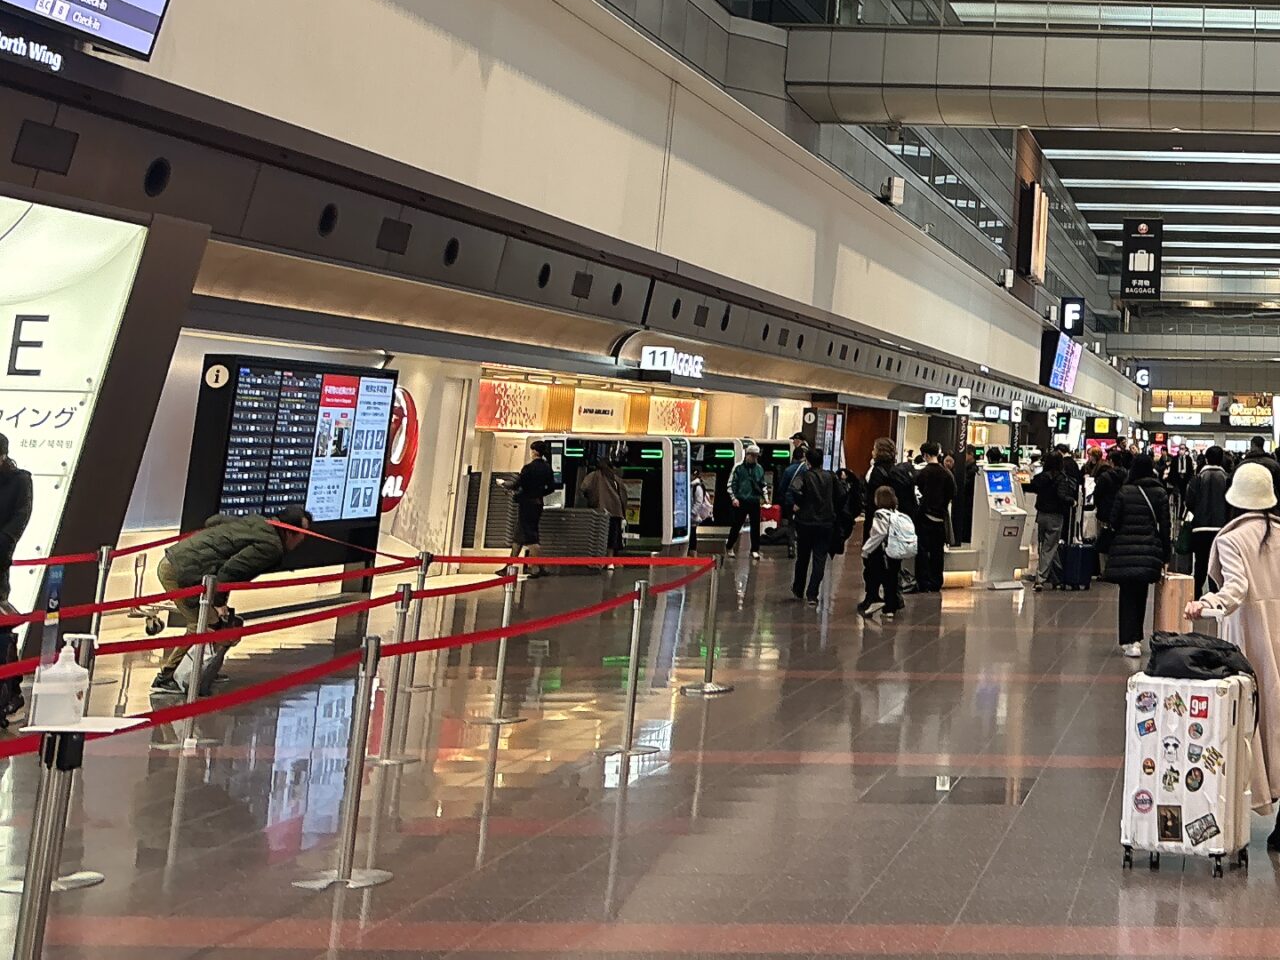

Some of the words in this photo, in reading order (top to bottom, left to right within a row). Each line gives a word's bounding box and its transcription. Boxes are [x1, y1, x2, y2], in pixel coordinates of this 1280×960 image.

[73, 12, 100, 30] Check-in
[0, 30, 27, 56] orth
[29, 41, 61, 71] Wing
[1131, 279, 1150, 287] 手荷物
[1064, 303, 1081, 330] F
[7, 314, 50, 376] E
[648, 350, 668, 367] 11
[671, 352, 704, 378] AGGAGE
[1136, 369, 1149, 385] G
[929, 395, 940, 406] 12
[945, 399, 957, 408] 13
[0, 406, 77, 429] イング
[1058, 416, 1067, 430] F
[381, 475, 403, 497] AL
